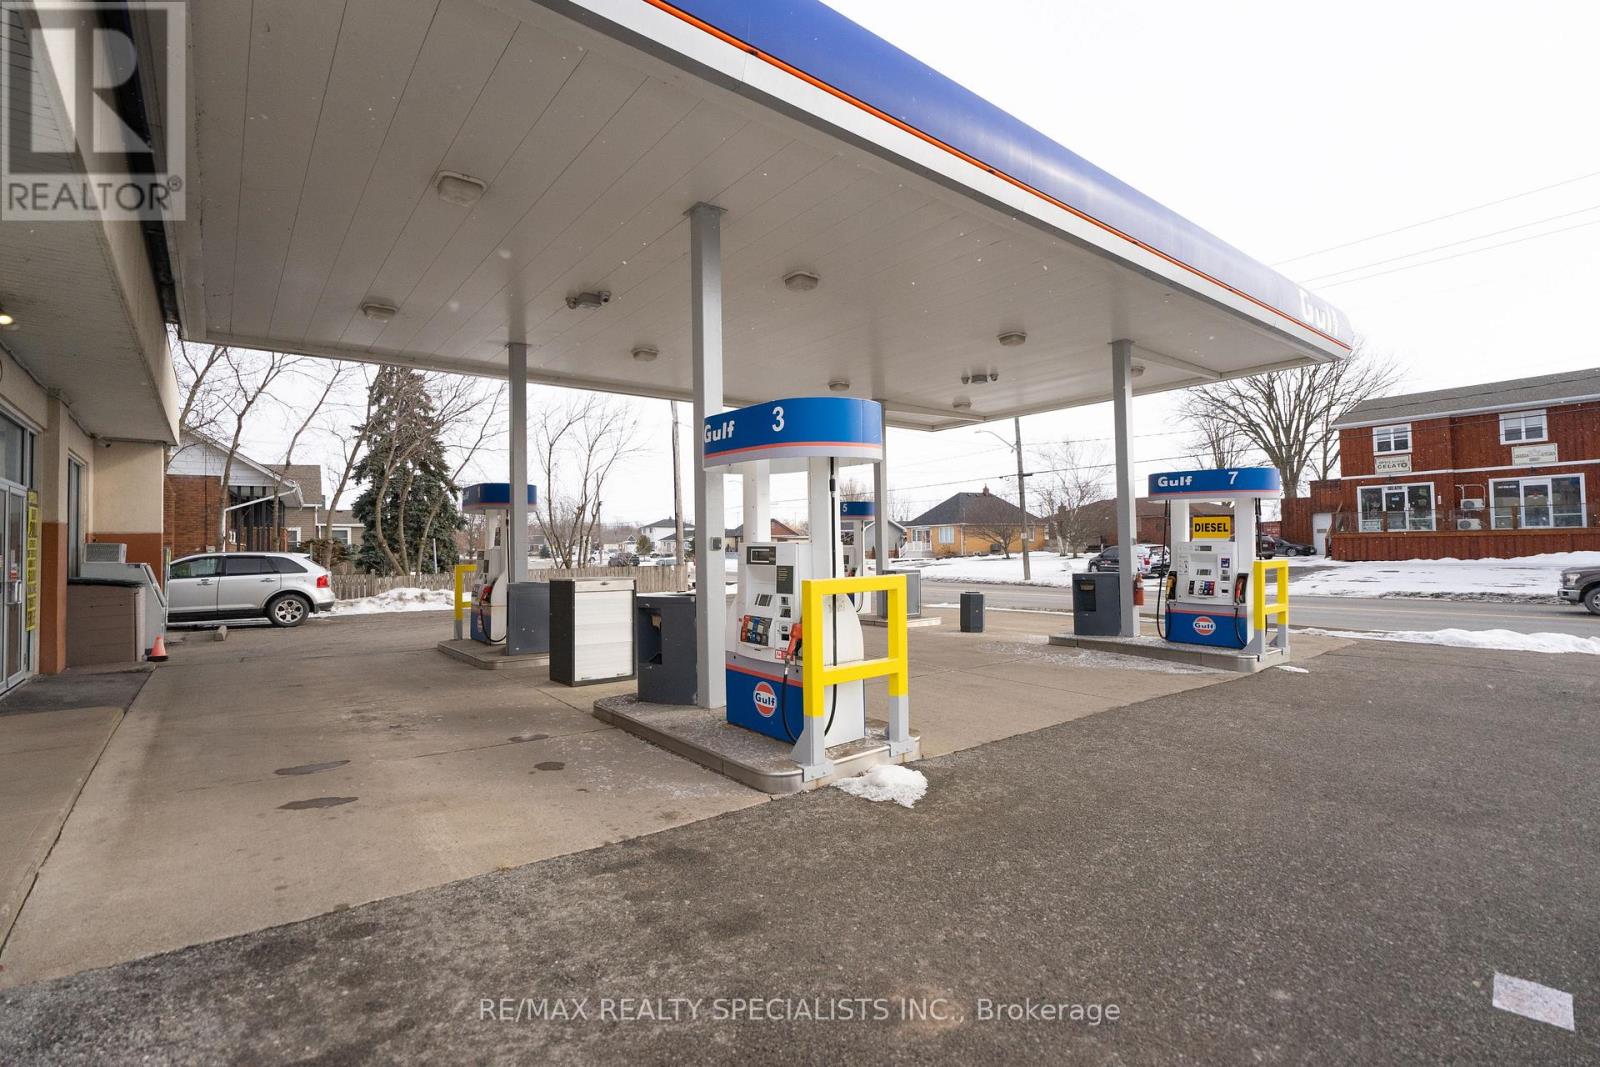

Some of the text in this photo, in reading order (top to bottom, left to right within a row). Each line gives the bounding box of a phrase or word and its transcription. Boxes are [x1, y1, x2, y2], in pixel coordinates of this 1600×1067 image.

[704, 406, 785, 443] Gulf 3
[1158, 471, 1238, 487] Gulf 7
[842, 503, 848, 512] 5
[1194, 522, 1229, 532] DIESEL
[1195, 622, 1214, 630] Gulf
[755, 692, 775, 706] Gulf
